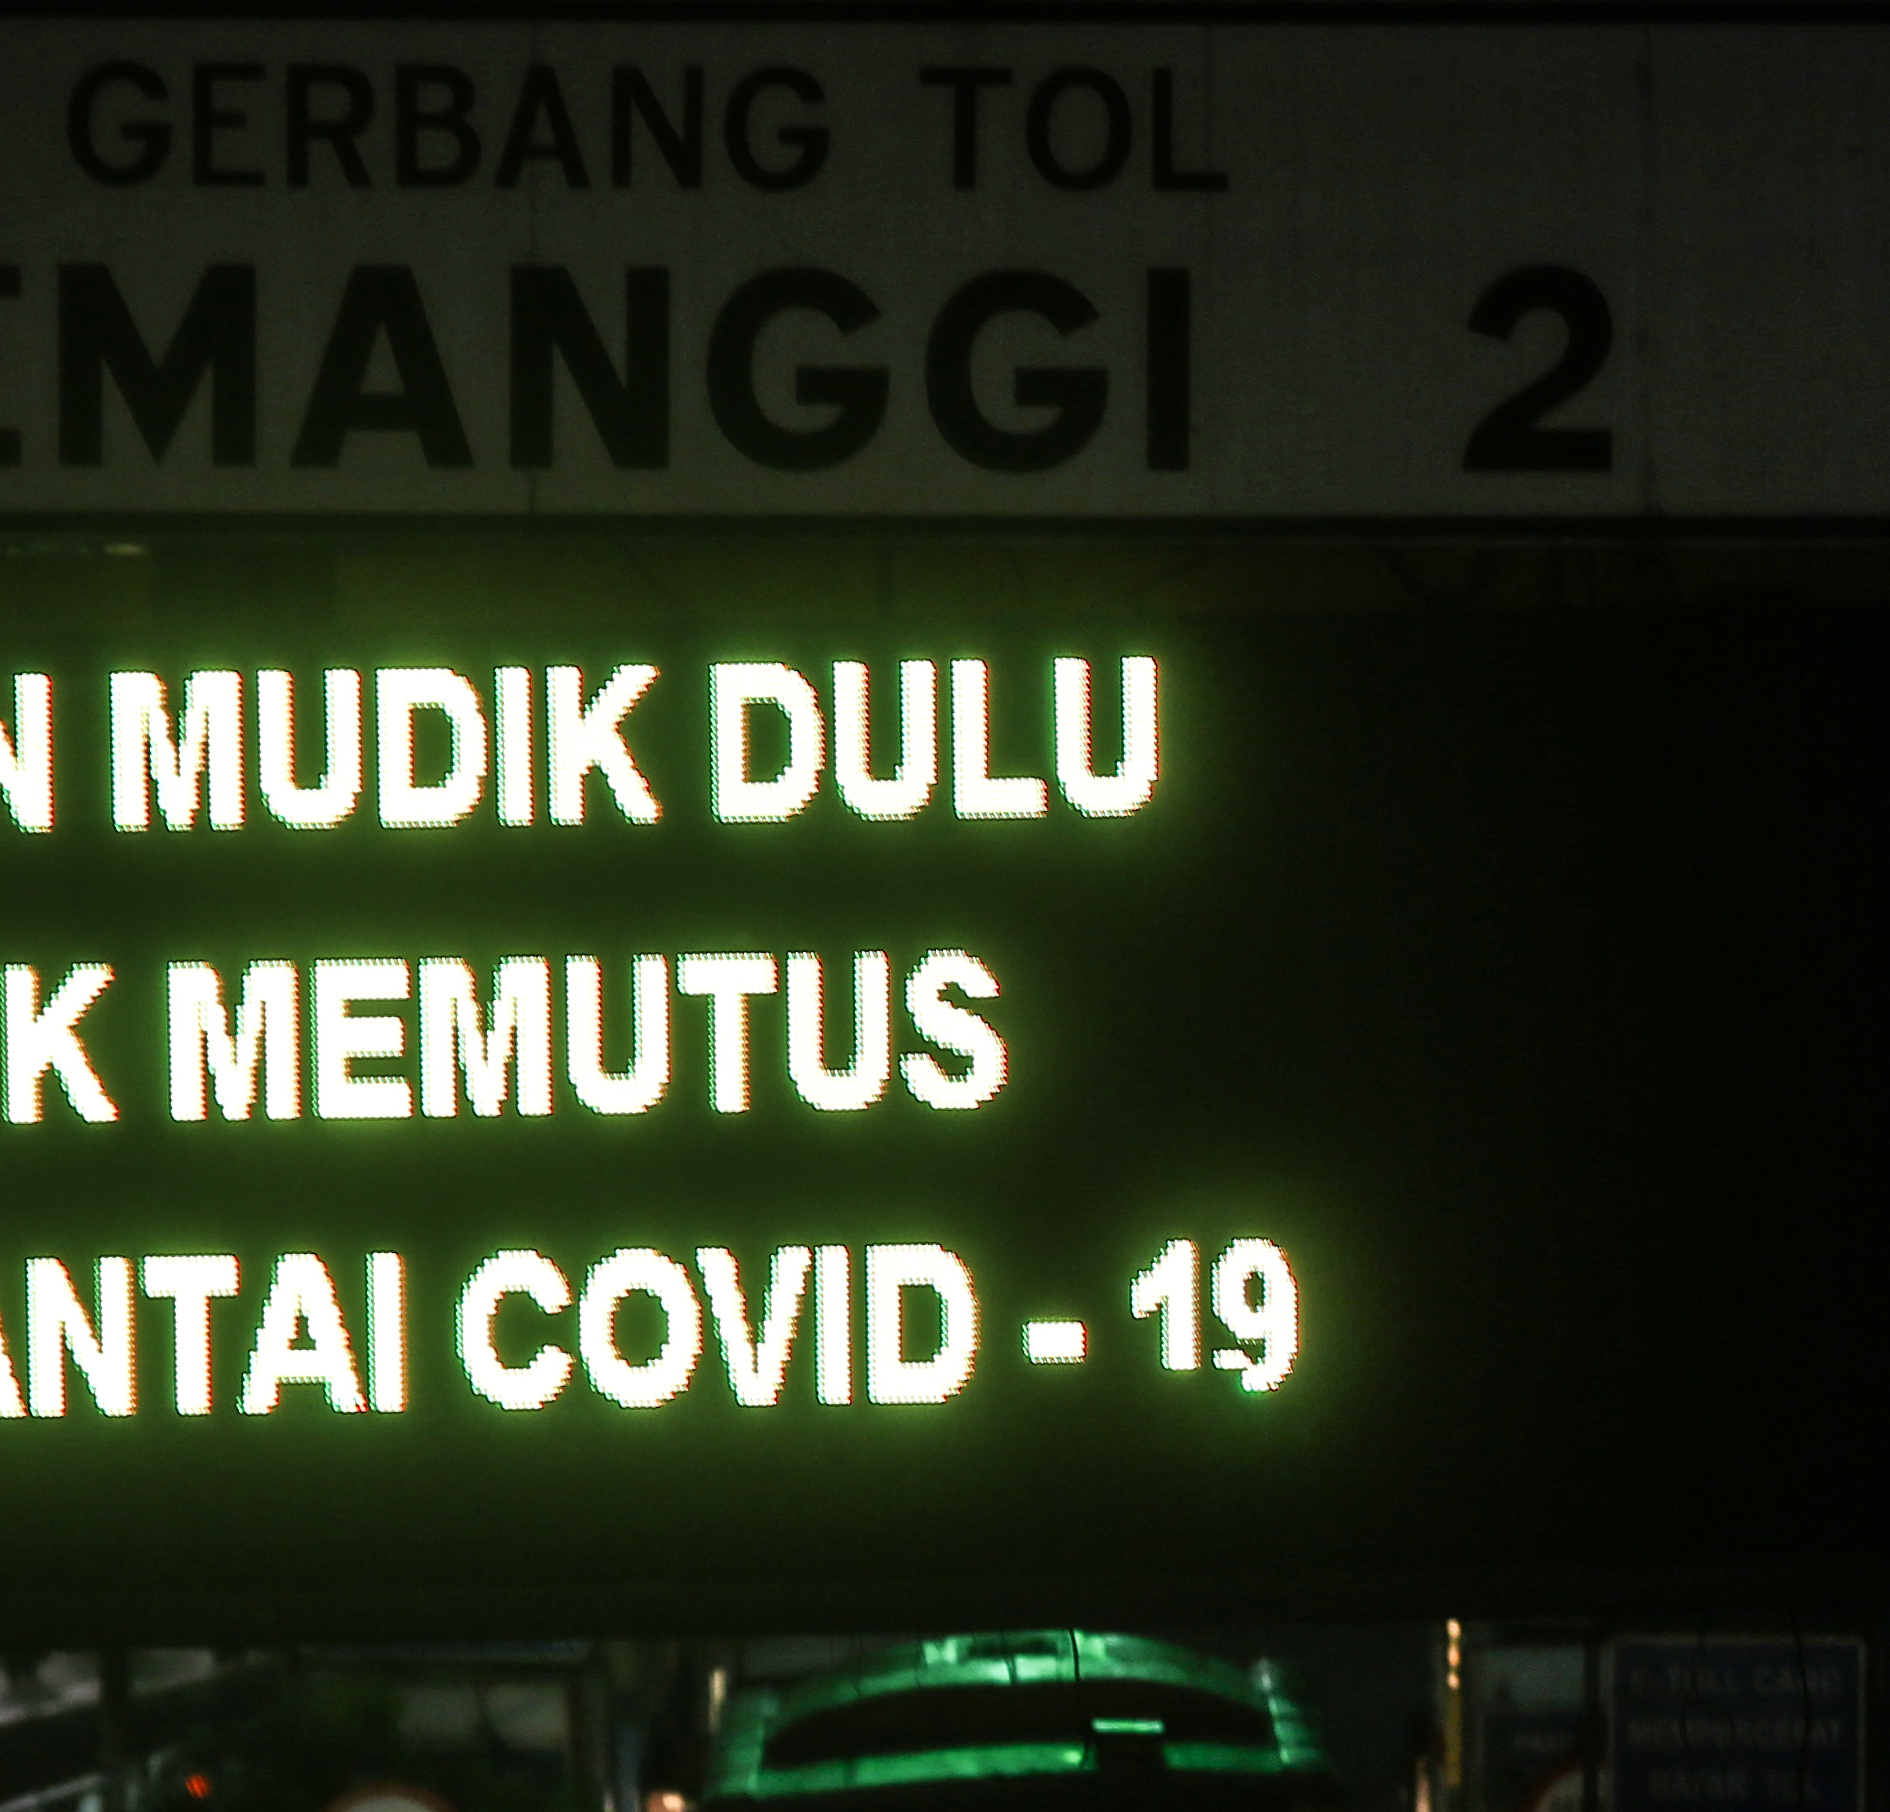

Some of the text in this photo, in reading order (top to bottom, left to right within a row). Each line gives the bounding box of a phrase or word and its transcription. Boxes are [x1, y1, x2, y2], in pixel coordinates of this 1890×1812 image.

[65, 60, 1229, 192] GERBANG TOL
[1463, 266, 1613, 472] 2
[111, 664, 661, 832] MUDIK
[710, 655, 1160, 823] DULU
[167, 950, 1007, 1122] MEMUTUS
[455, 1243, 978, 1411] COVID
[1130, 1238, 1300, 1394] 19
